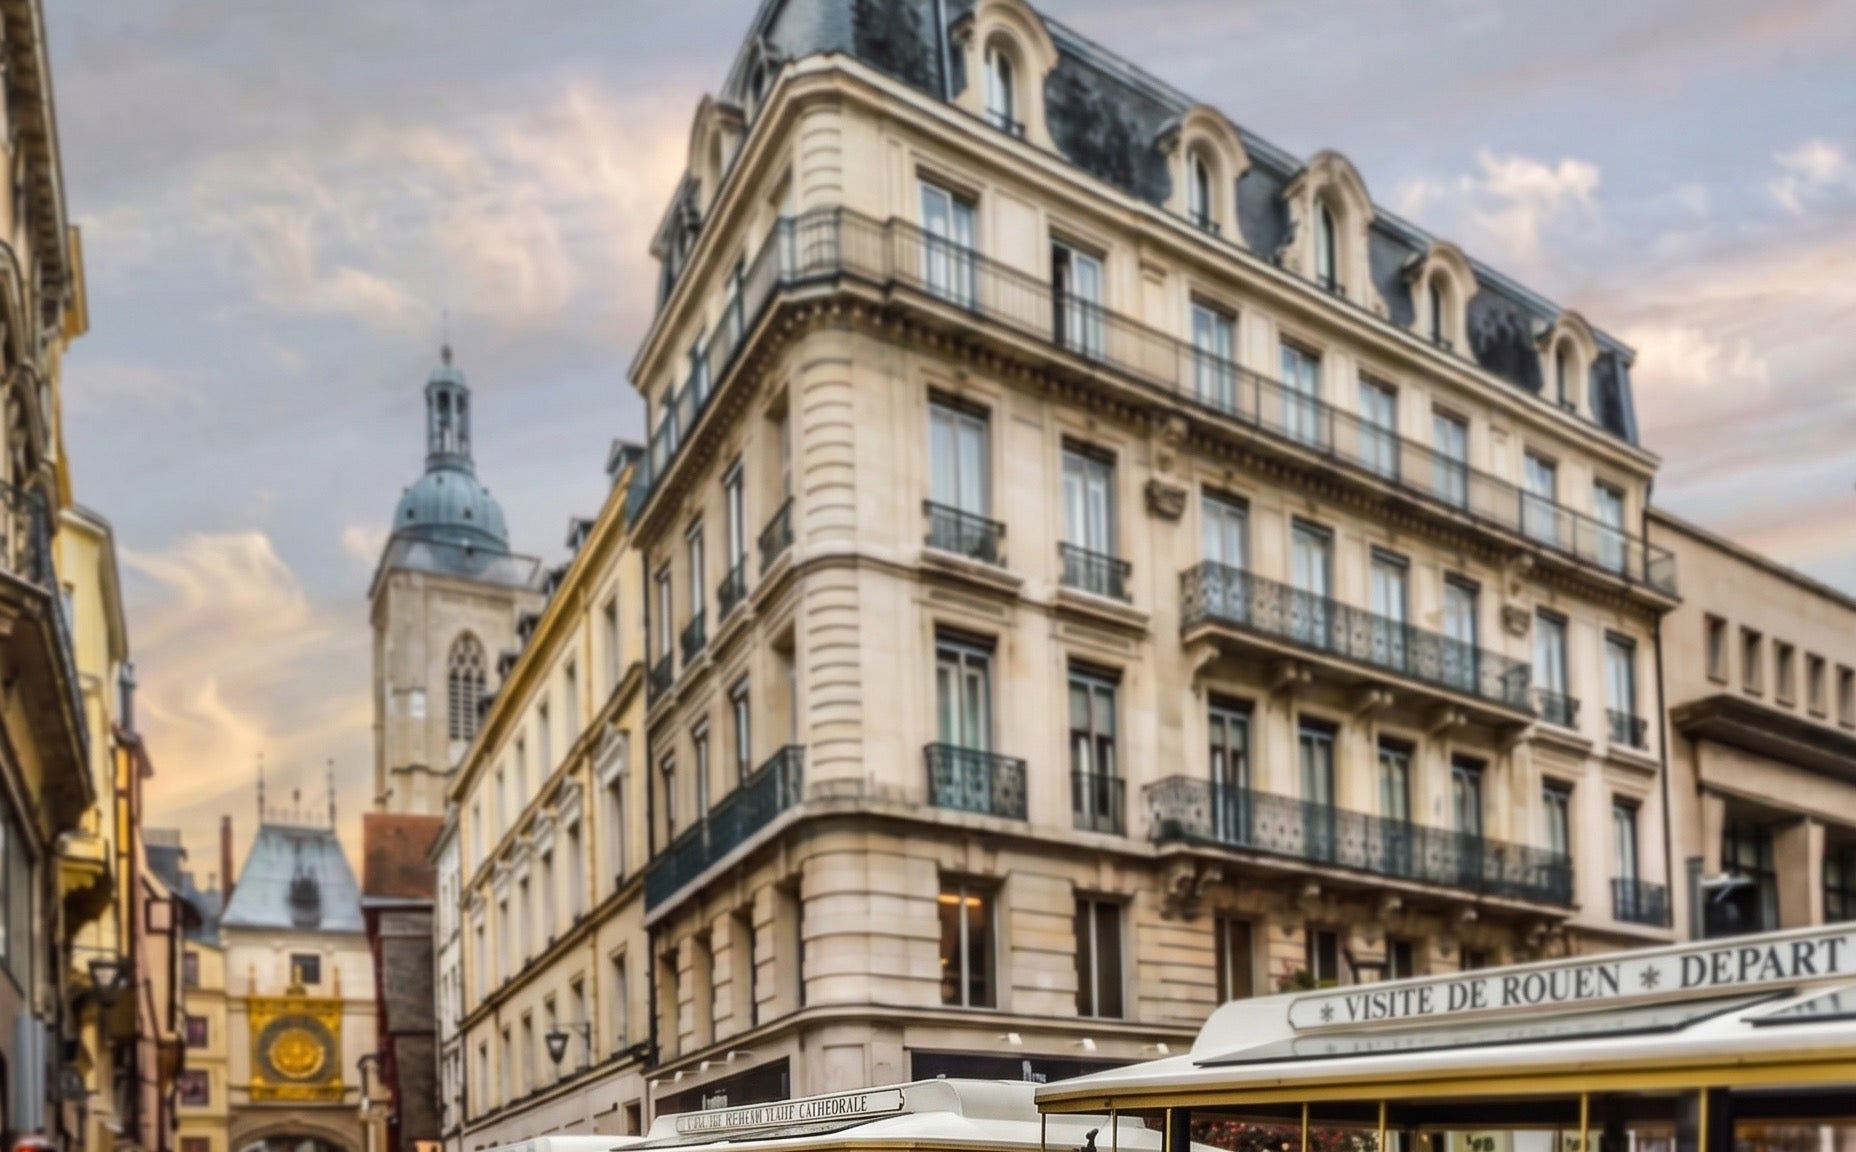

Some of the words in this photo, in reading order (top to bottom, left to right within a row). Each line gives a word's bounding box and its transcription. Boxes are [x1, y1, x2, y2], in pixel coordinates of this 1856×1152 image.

[1345, 985, 1434, 1021] VISITE
[1447, 979, 1488, 1012] DE
[1502, 963, 1621, 1006] ROUEN
[1679, 936, 1847, 988] DEPART
